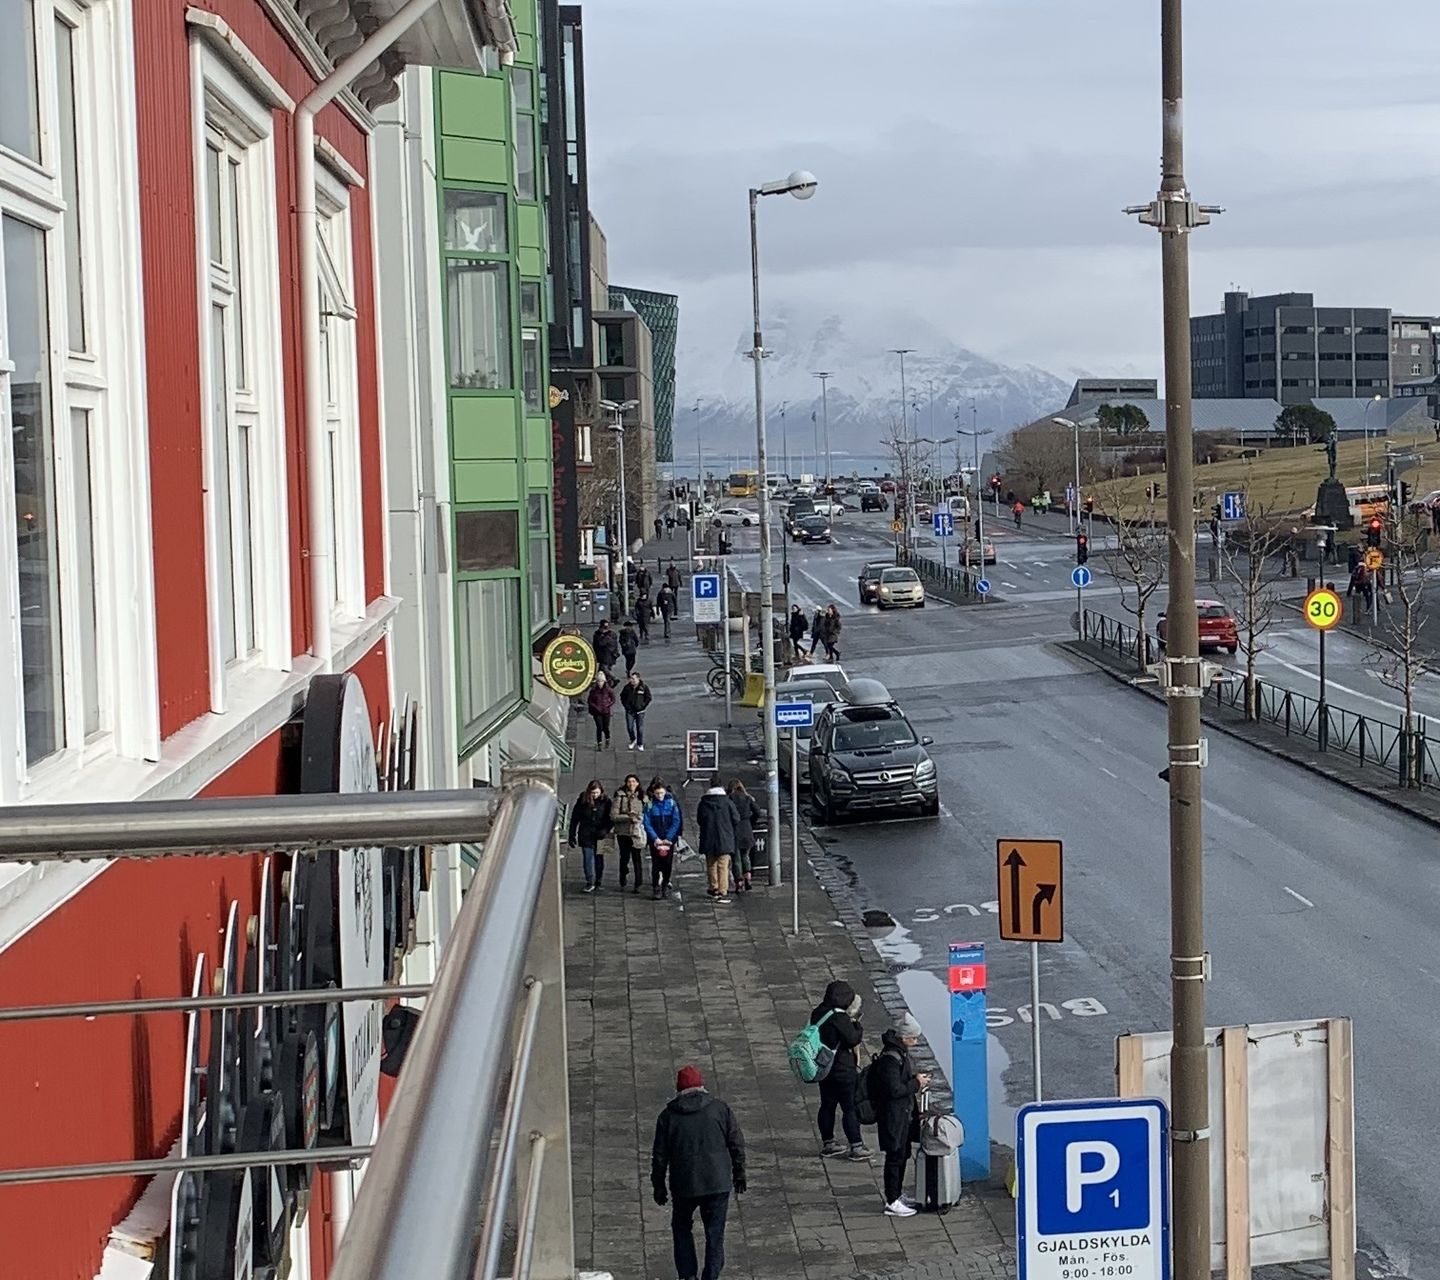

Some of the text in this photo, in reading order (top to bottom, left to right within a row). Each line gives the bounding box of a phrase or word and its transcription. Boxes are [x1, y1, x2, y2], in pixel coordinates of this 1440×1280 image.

[1310, 601, 1335, 617] 30
[1066, 1141, 1120, 1213] P
[1037, 1235, 1151, 1253] GJALDSKYLDA
[1062, 1268, 1089, 1279] 9:00
[1100, 1265, 1133, 1277] 18:00
